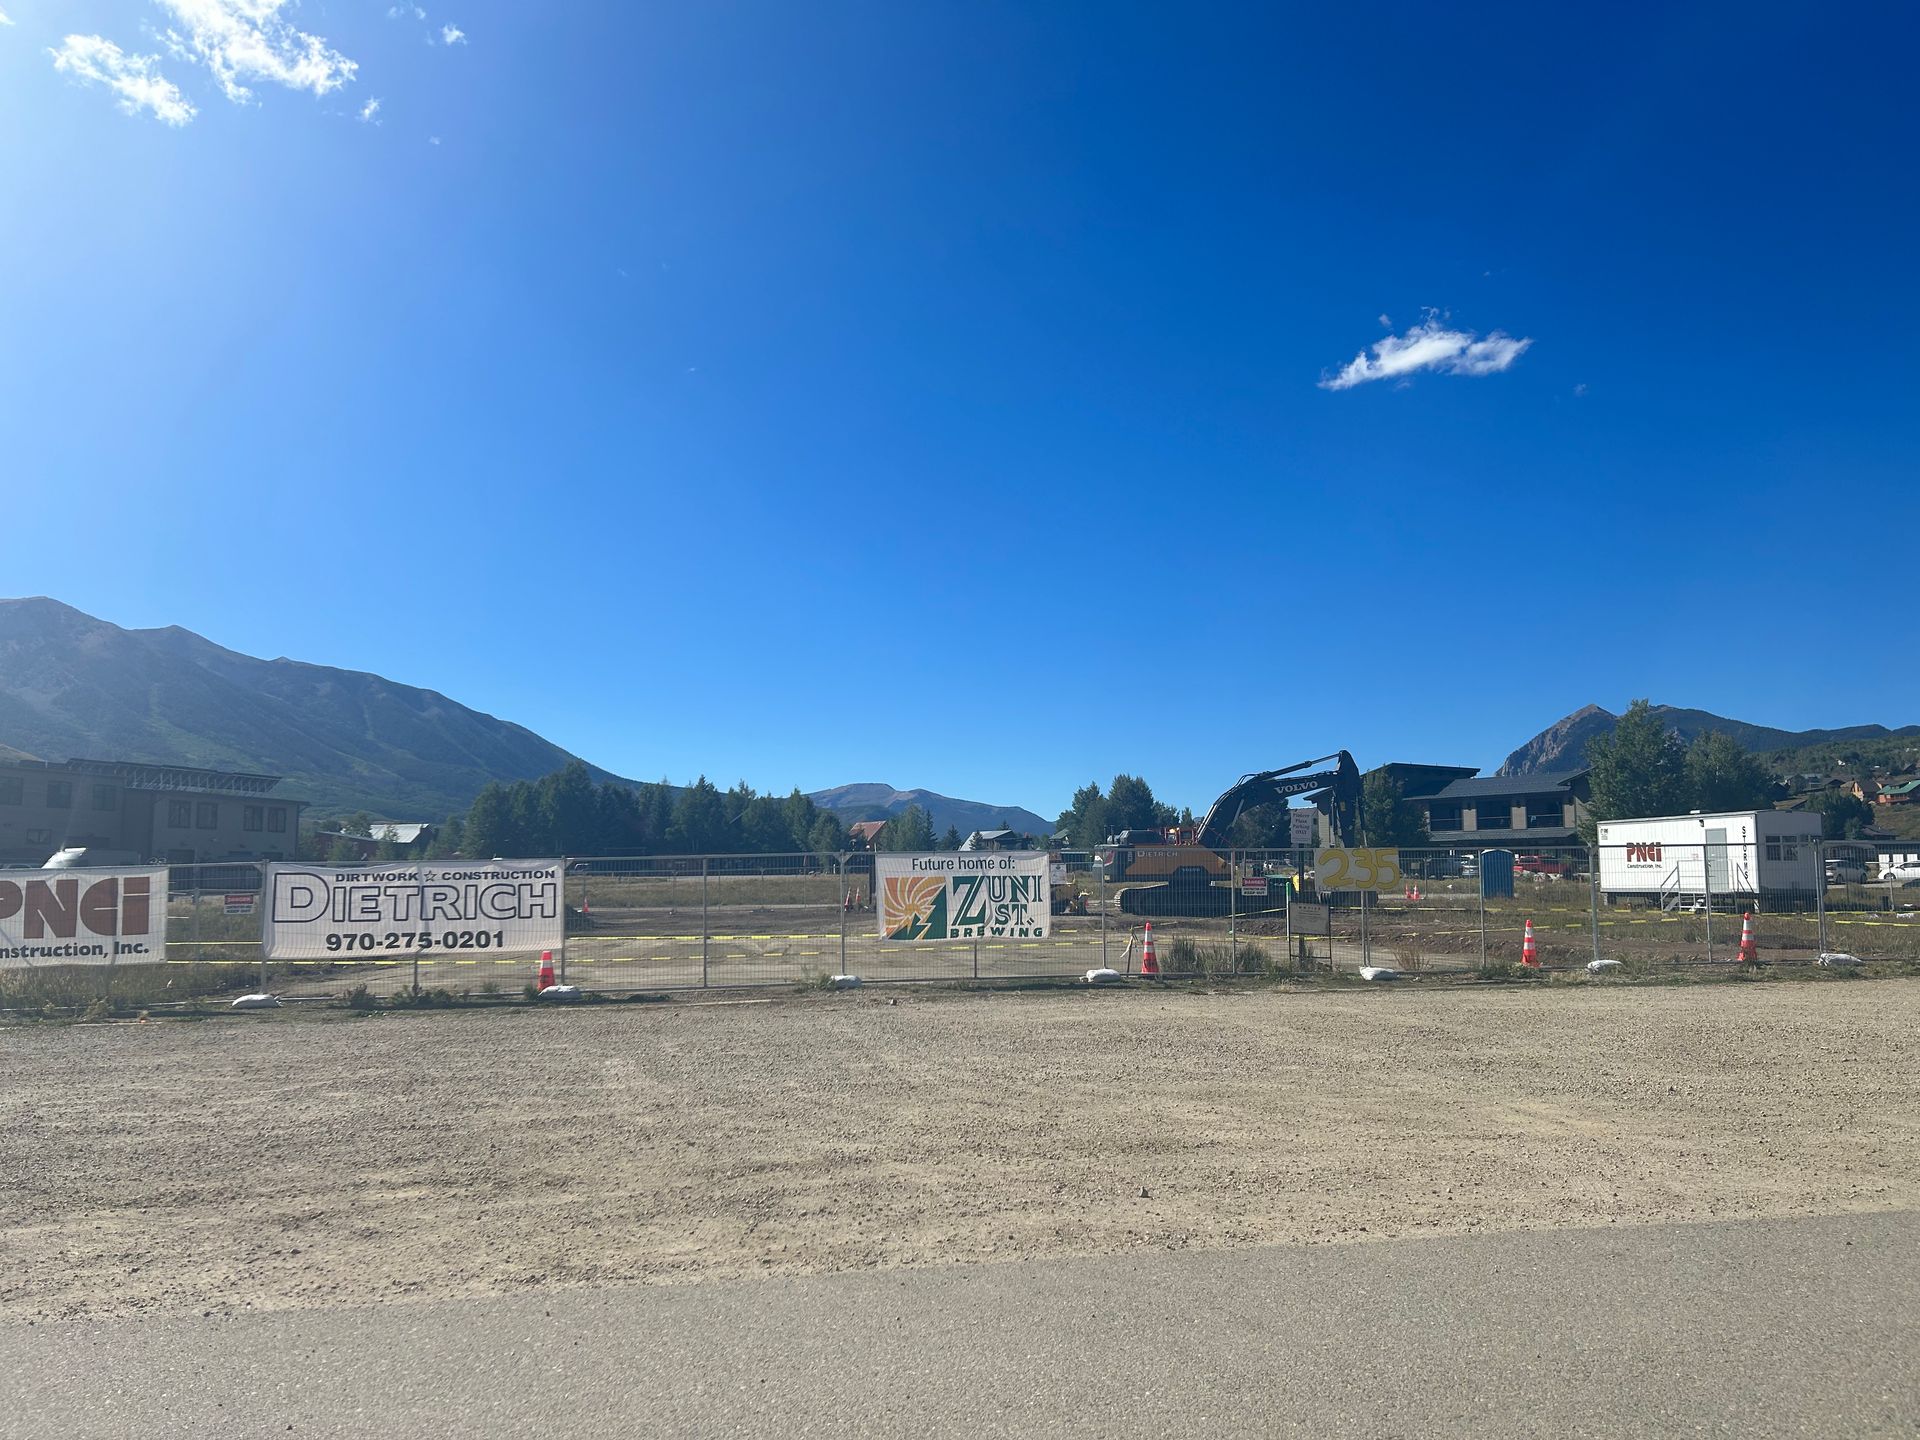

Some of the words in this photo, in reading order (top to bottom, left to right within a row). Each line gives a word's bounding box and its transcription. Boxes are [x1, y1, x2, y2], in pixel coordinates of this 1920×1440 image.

[1274, 781, 1318, 794] VOLVO
[912, 858, 954, 870] Future
[958, 856, 995, 870] home
[999, 856, 1015, 870] of:
[1318, 848, 1400, 890] 235
[335, 872, 419, 882] DIRTWORK
[441, 870, 555, 881] CONSTRUCTION
[951, 875, 1043, 926] ZUNI
[950, 926, 1043, 938] BREWING
[114, 941, 149, 955] Inc.
[326, 931, 504, 951] 970-275-0201
